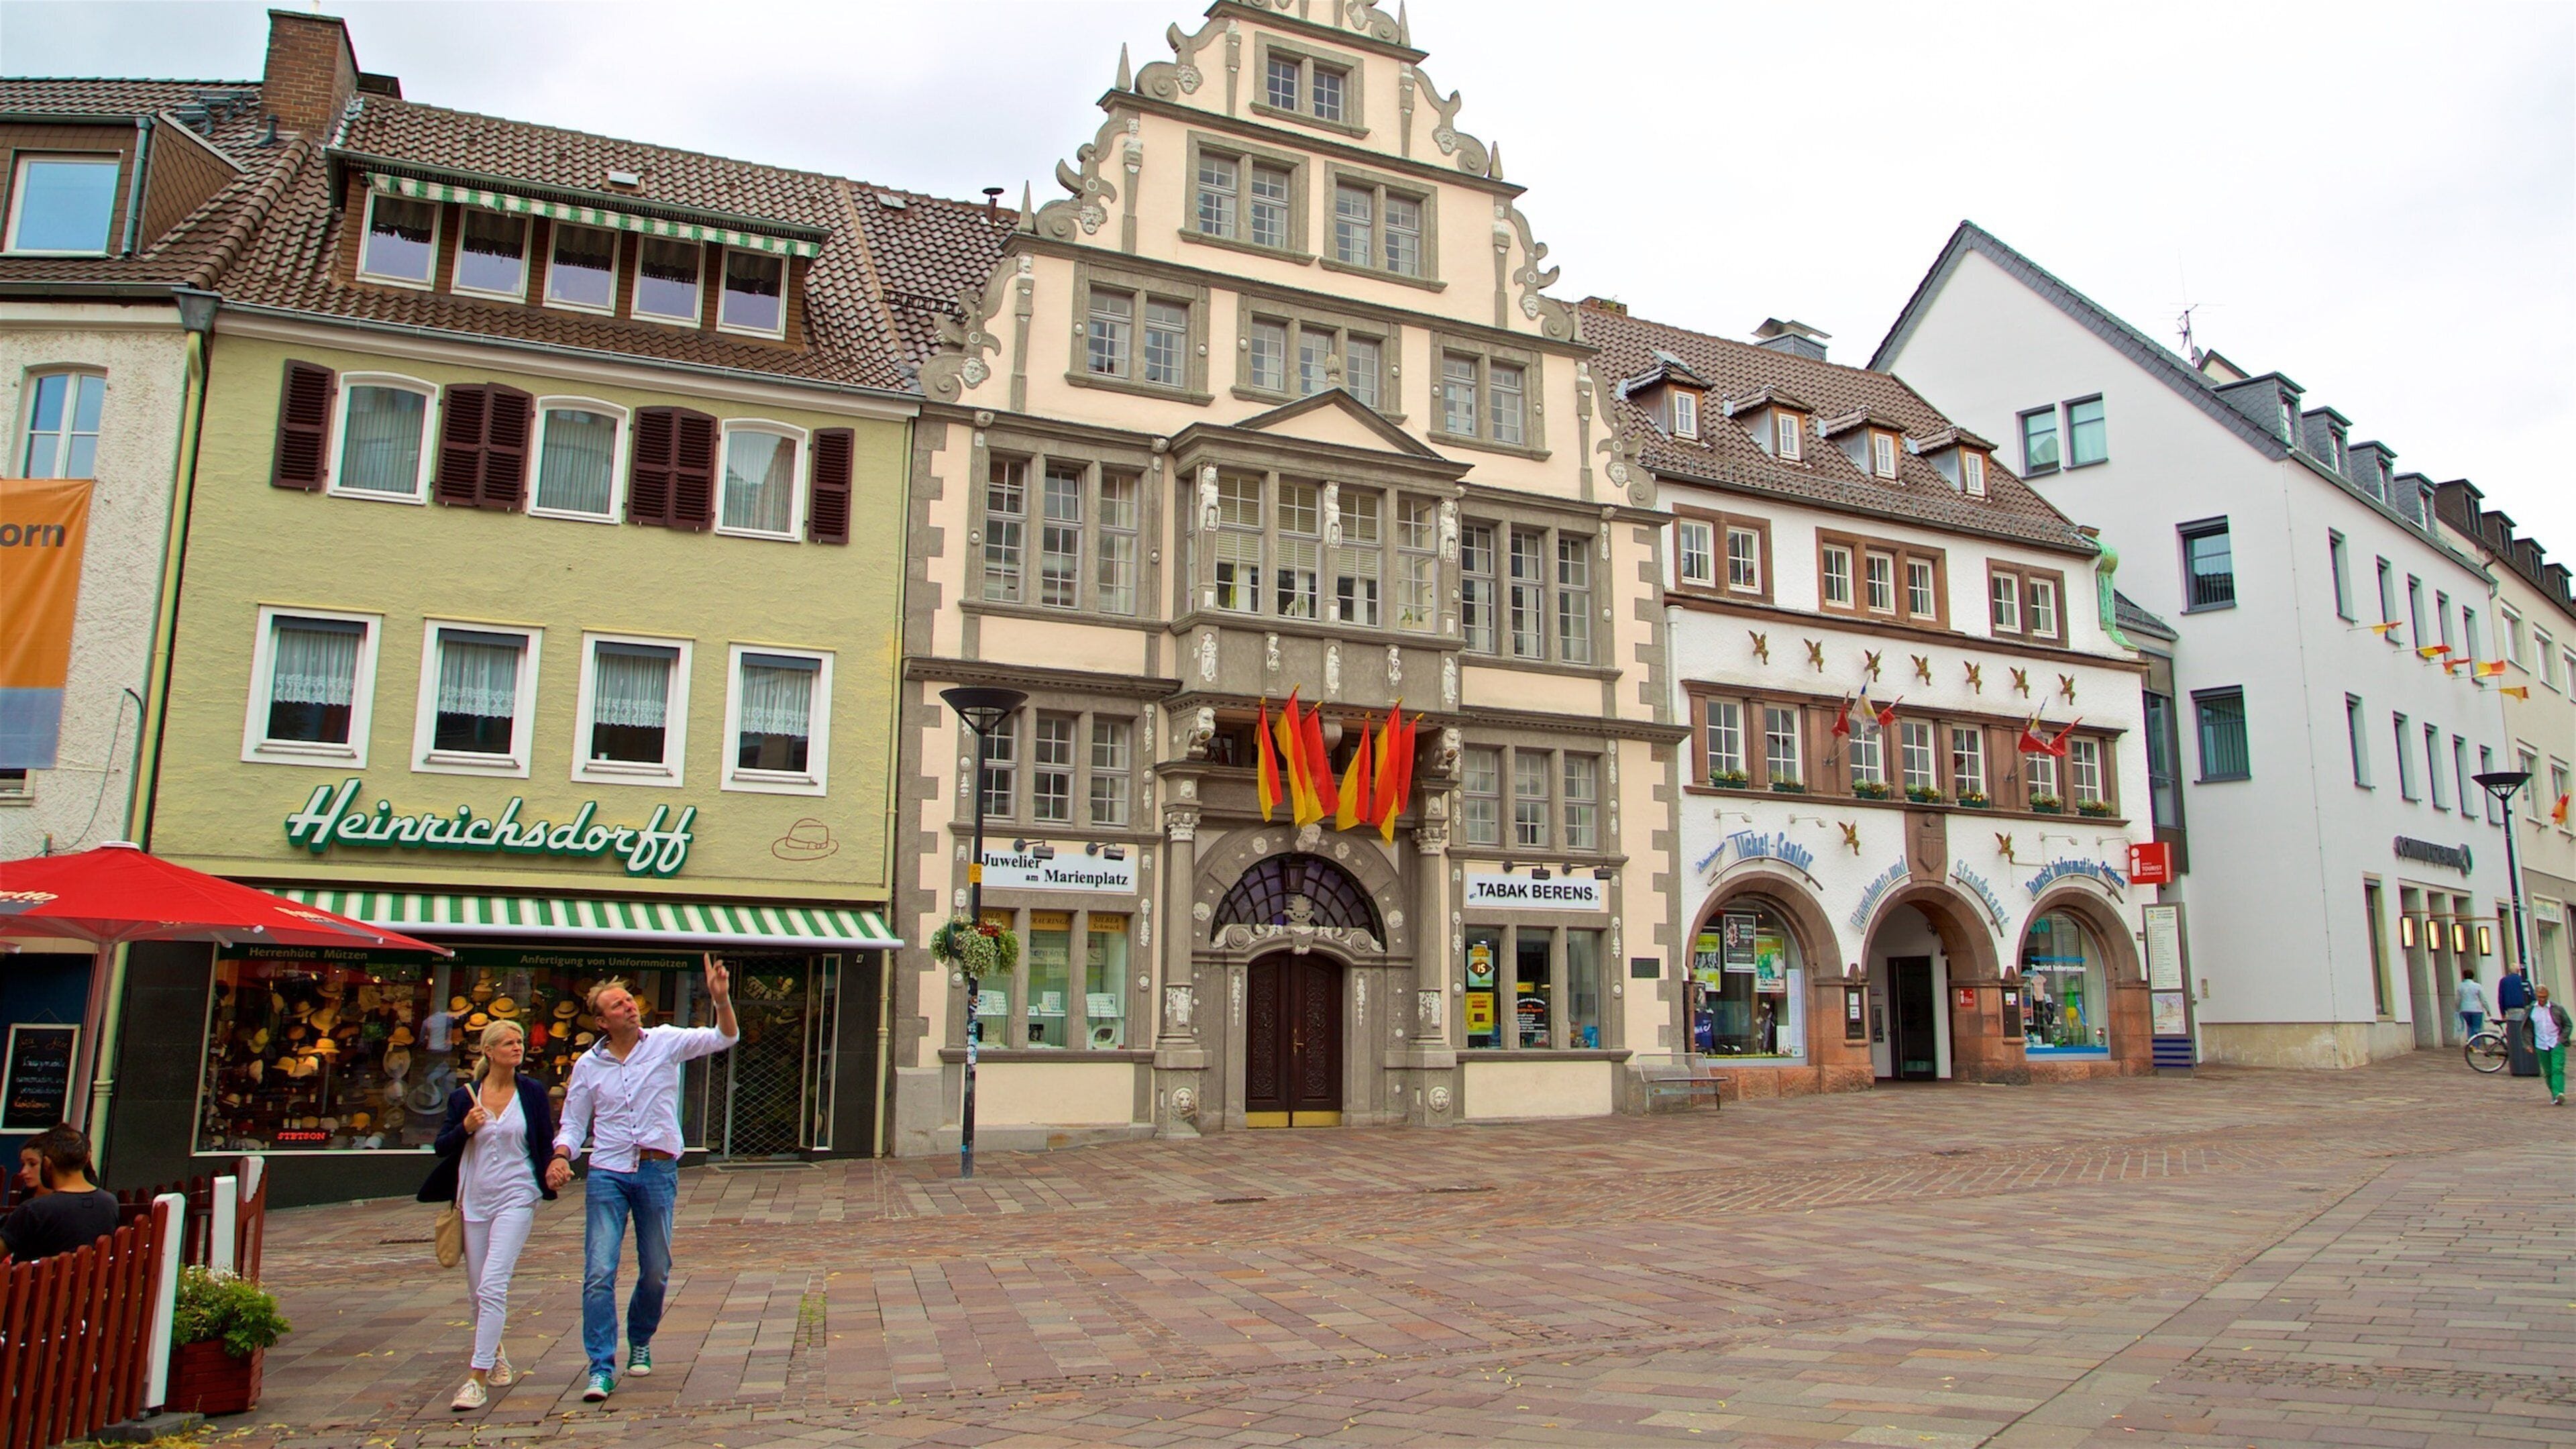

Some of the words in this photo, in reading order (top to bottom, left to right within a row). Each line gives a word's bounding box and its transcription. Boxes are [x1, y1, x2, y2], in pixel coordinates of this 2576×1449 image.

[286, 778, 696, 875] Heinrichsdorff
[982, 853, 1042, 869] Juwelier
[1044, 869, 1128, 888] Marienplatz
[2025, 863, 2055, 896] Tourist
[2051, 855, 2100, 878] Information
[1477, 883, 1528, 898] TABAK
[1532, 884, 1593, 900] BERENS
[1955, 859, 2010, 926] Standesamt
[249, 947, 317, 959] Herrenhüte
[324, 949, 368, 960] Mützen
[520, 955, 584, 967] Anfertigung
[587, 957, 604, 966] von
[608, 957, 688, 968] Uniformmützen
[2053, 964, 2086, 972] Information
[277, 1132, 326, 1140] STETSON
